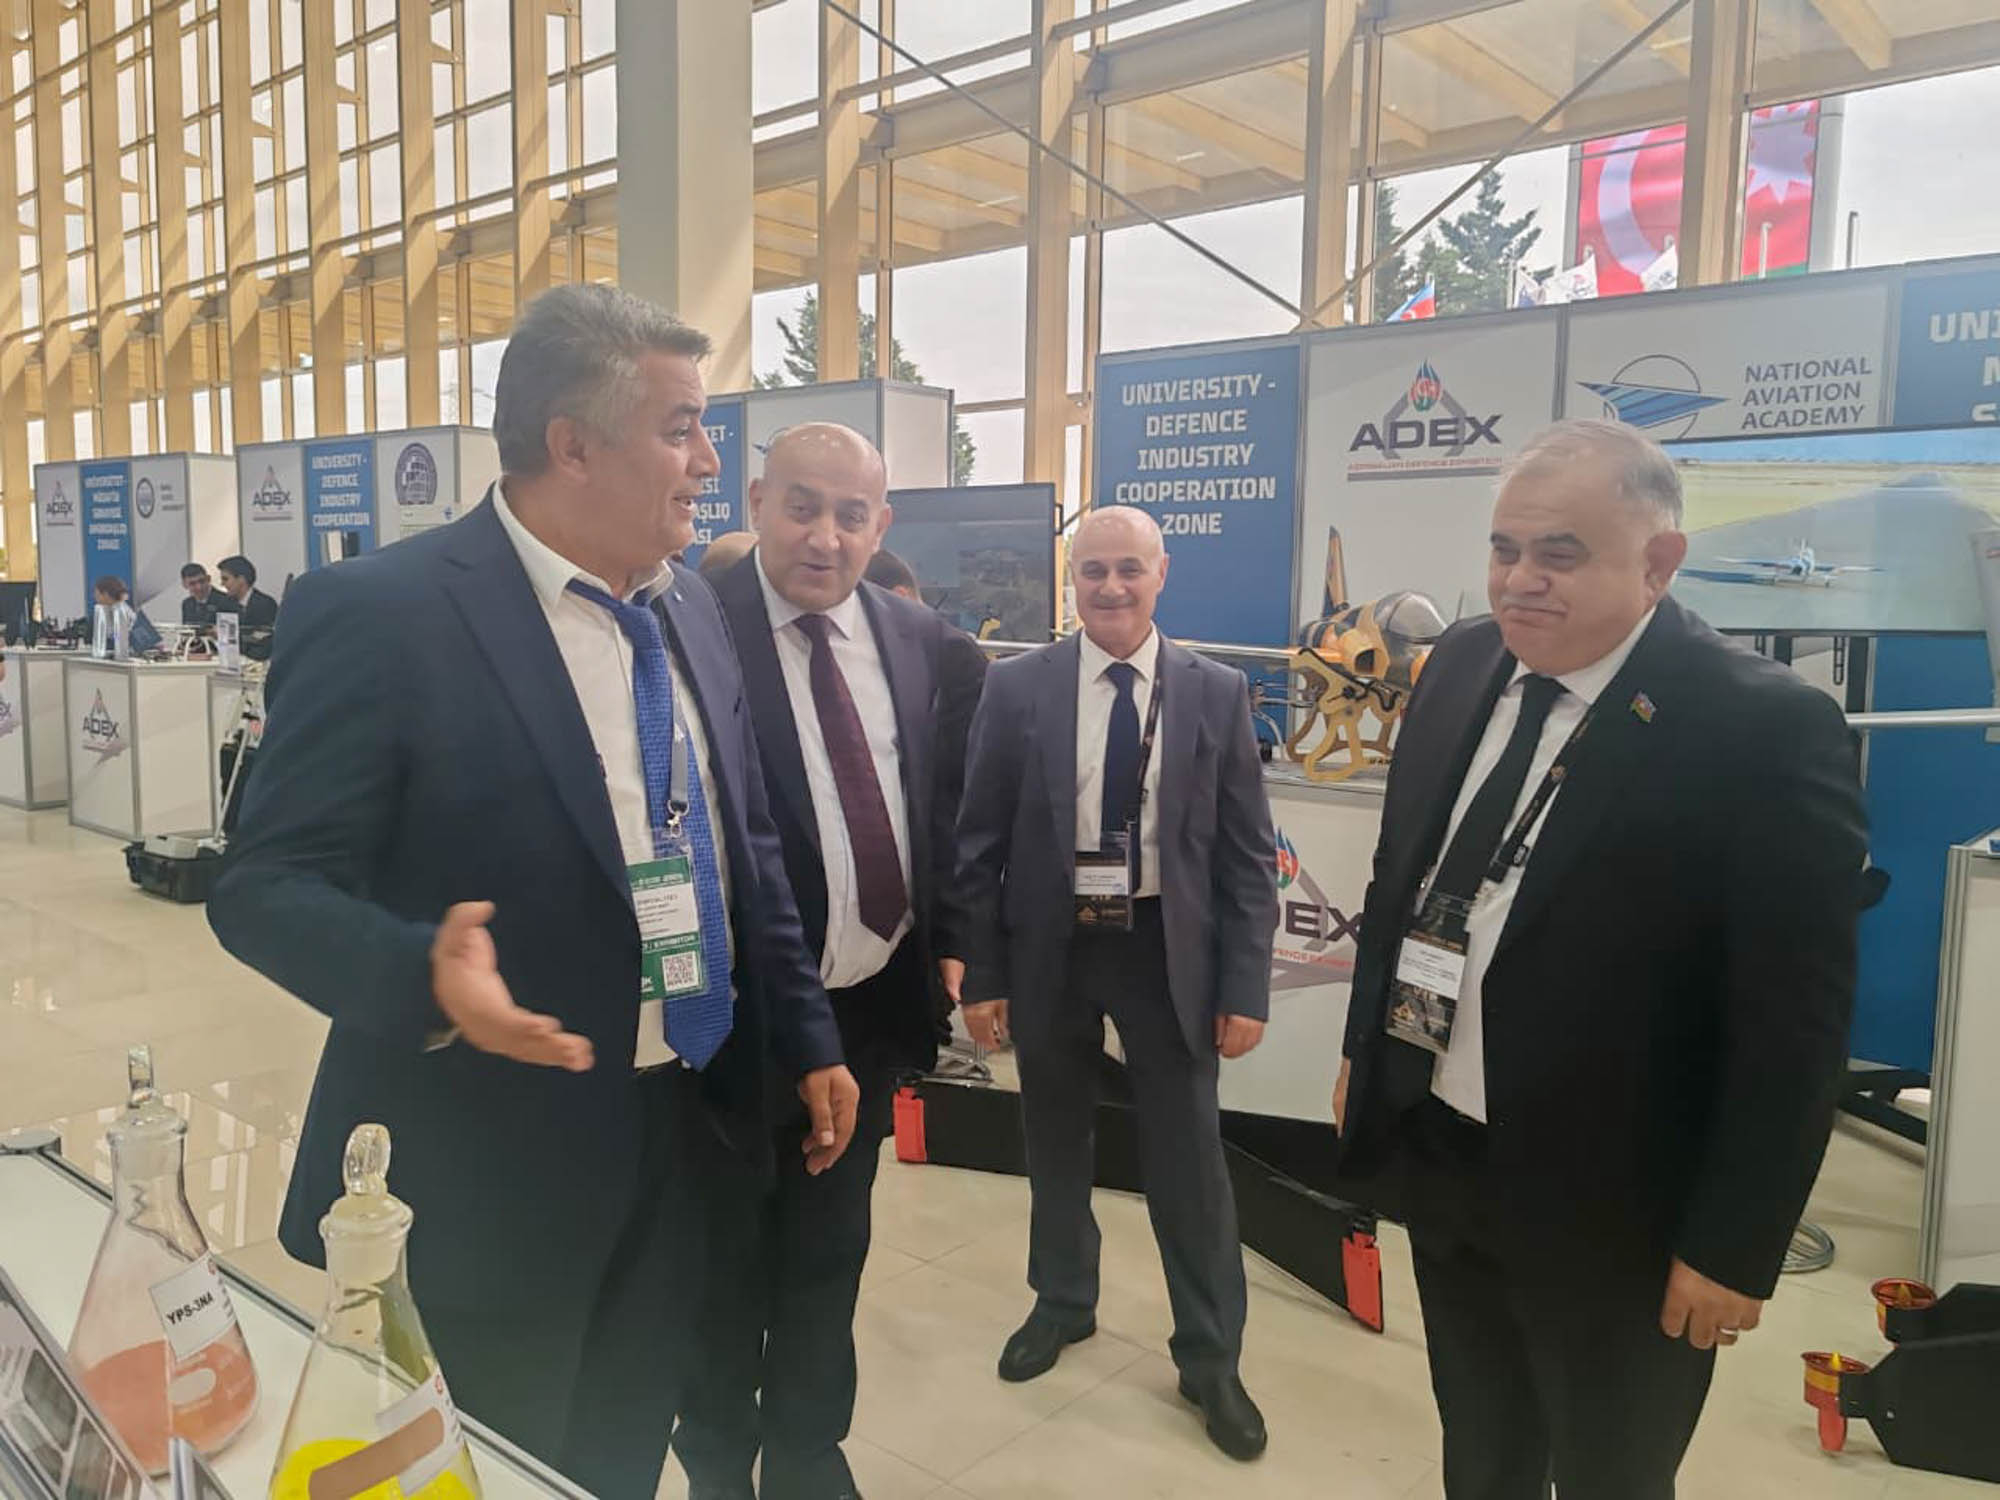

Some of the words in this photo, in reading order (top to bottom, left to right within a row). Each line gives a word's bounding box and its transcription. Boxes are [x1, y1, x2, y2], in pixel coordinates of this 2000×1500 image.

[1745, 356, 1872, 383] NATIONAL
[1122, 373, 1262, 406] UNIVERSITY
[1743, 381, 1861, 407] AVIATION
[1146, 409, 1248, 439] DEFENCE
[1741, 404, 1865, 430] ACADEMY
[1350, 414, 1502, 452] ADEX
[1137, 442, 1255, 470] INDUSTRY
[252, 491, 291, 506] ADEX
[1115, 476, 1276, 505] COOPERATION
[1161, 512, 1222, 536] ZONE
[82, 716, 119, 739] ADEX
[1277, 900, 1365, 943] EX
